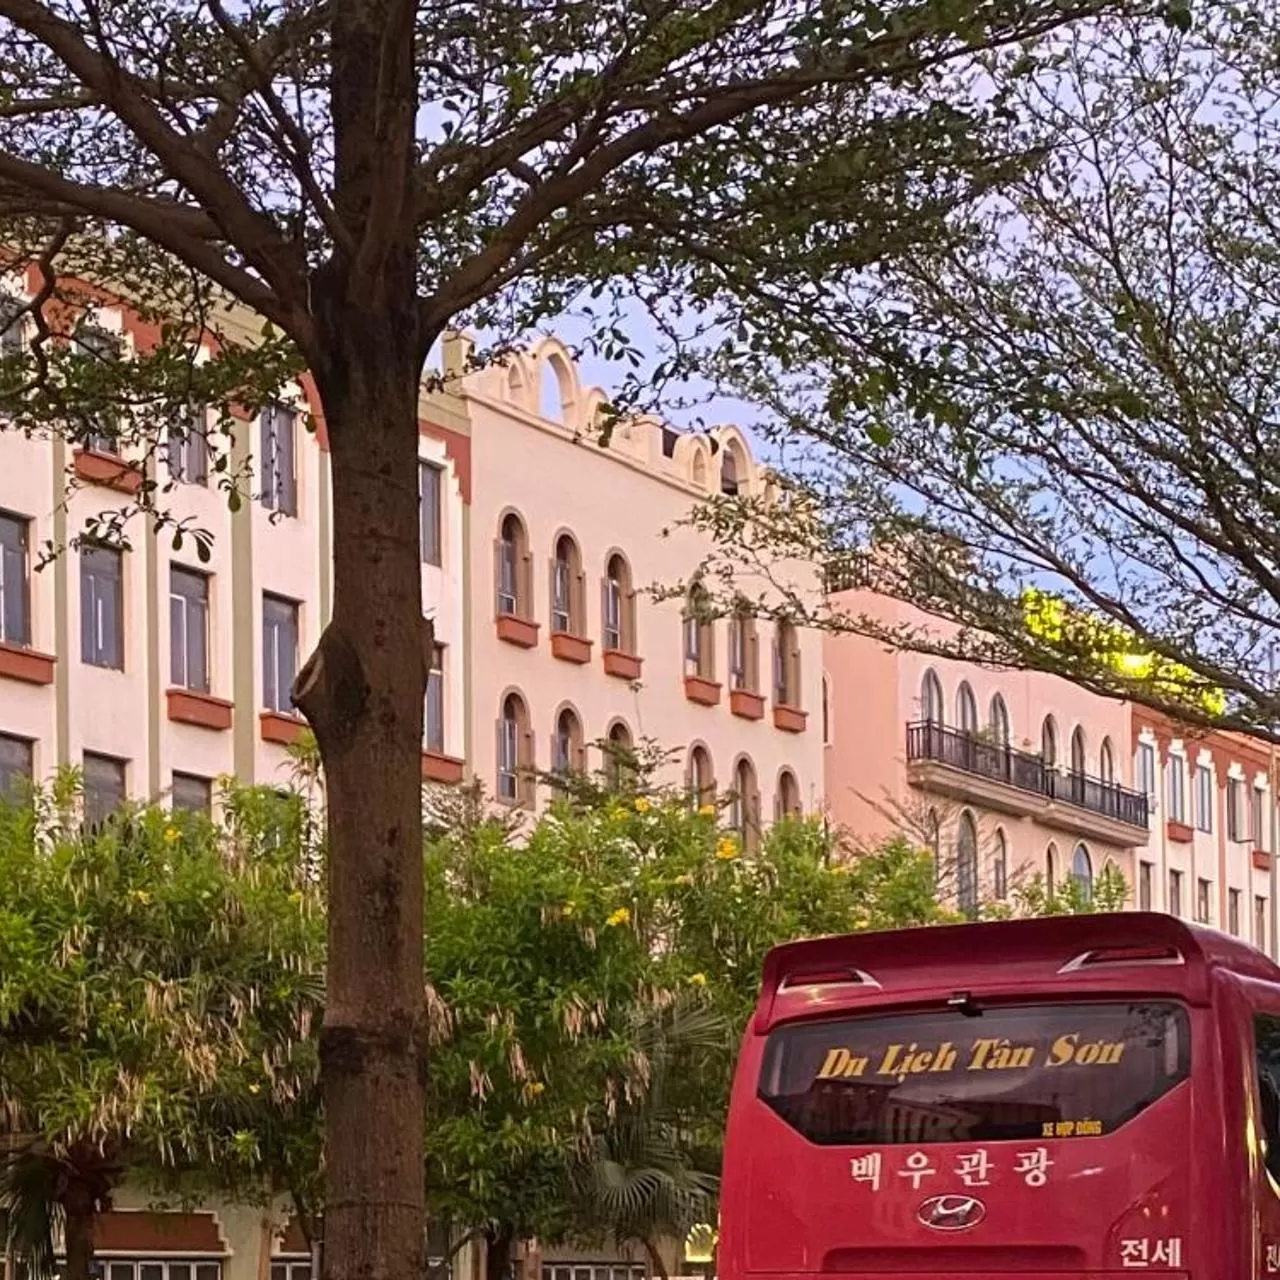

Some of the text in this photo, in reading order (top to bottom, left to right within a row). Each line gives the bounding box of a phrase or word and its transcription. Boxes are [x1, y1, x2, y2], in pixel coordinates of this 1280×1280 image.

[816, 1033, 1125, 1083] Du Lịch Tân Sơn
[1120, 1238, 1181, 1267] 전세
